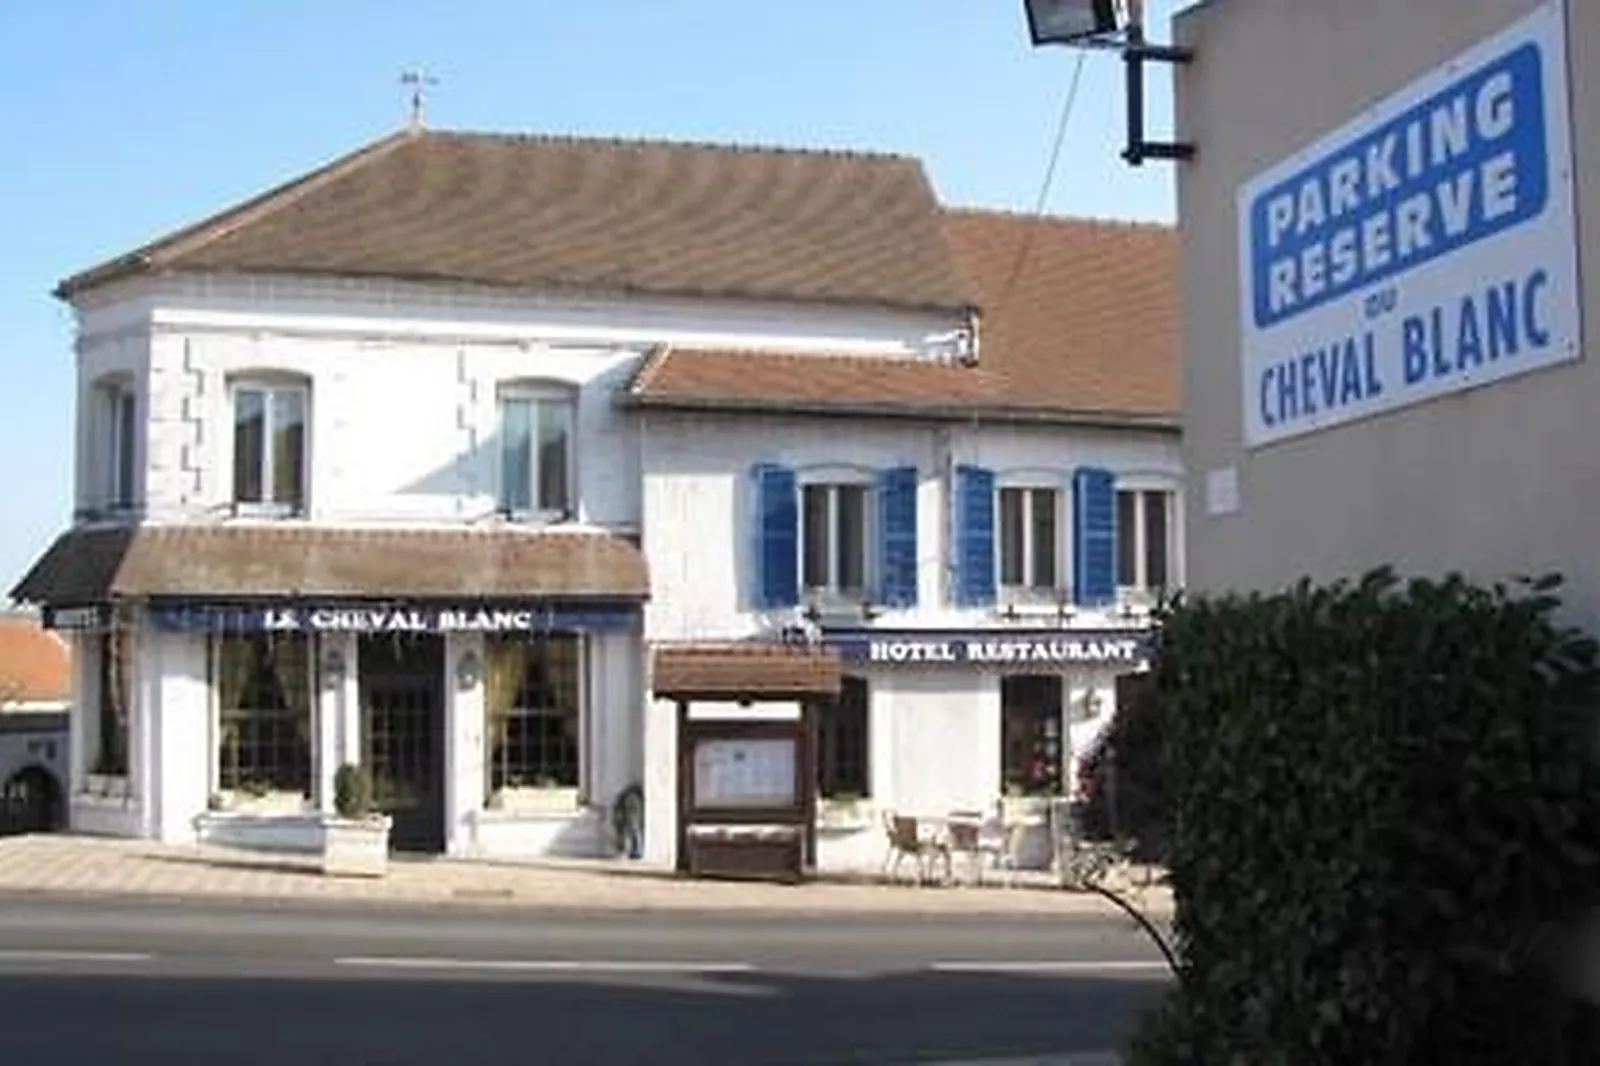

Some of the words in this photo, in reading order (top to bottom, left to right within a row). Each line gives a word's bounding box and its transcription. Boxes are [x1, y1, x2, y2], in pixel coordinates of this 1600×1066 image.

[1267, 72, 1515, 246] PARKING
[1269, 151, 1517, 311] RESERVE
[1260, 333, 1382, 428] CHEVAL
[1403, 269, 1549, 386] BLANC
[264, 609, 300, 629] LE
[310, 609, 427, 630] CHEVAL
[439, 609, 532, 630] BLANC
[870, 640, 956, 661] HOTEL
[967, 639, 1137, 661] RESTAURANT
